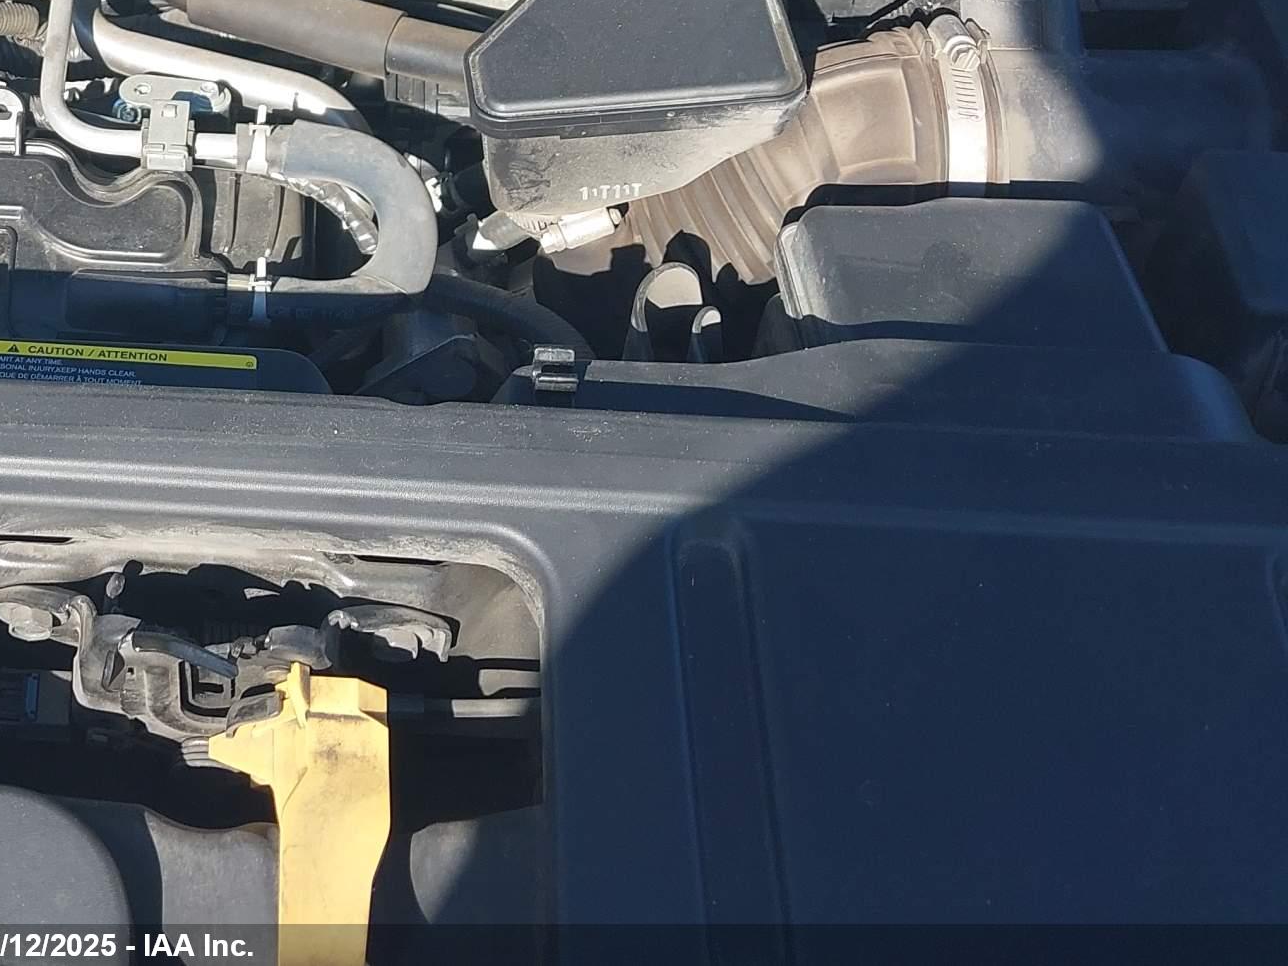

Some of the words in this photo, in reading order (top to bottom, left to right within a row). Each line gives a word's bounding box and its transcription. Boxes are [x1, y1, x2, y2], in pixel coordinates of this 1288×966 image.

[27, 345, 84, 356] CAUTION
[97, 350, 168, 362] ATTENTION
[78, 367, 106, 375] HANDS
[108, 369, 136, 377] CLEAR.
[30, 373, 75, 382] DÉMARRER
[83, 376, 106, 384] TOUT
